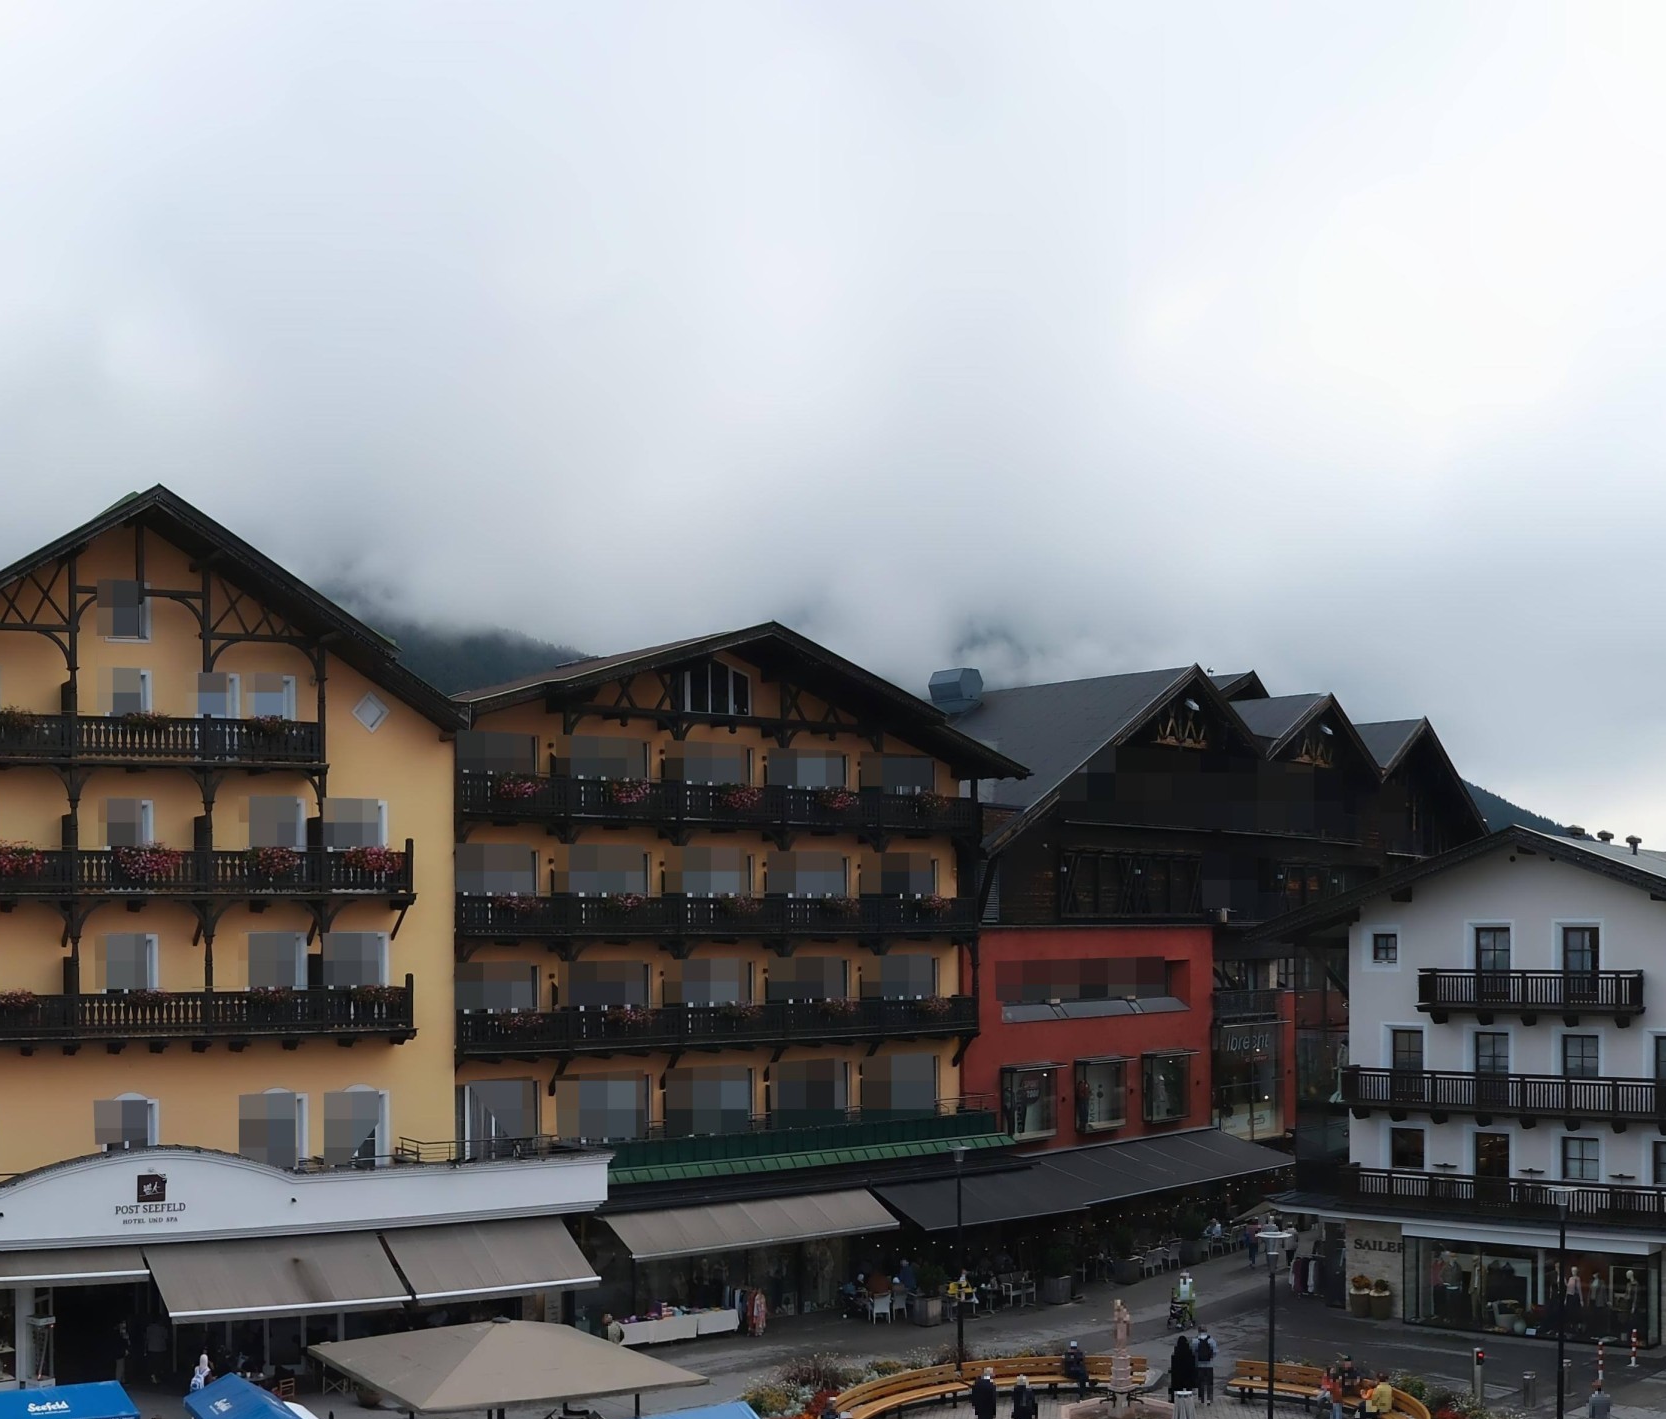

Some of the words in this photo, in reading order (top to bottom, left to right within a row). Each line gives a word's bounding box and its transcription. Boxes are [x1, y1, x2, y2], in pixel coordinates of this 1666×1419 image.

[115, 1205, 141, 1215] POST
[143, 1203, 186, 1213] SEEFELD
[27, 1400, 70, 1413] Seefeld
